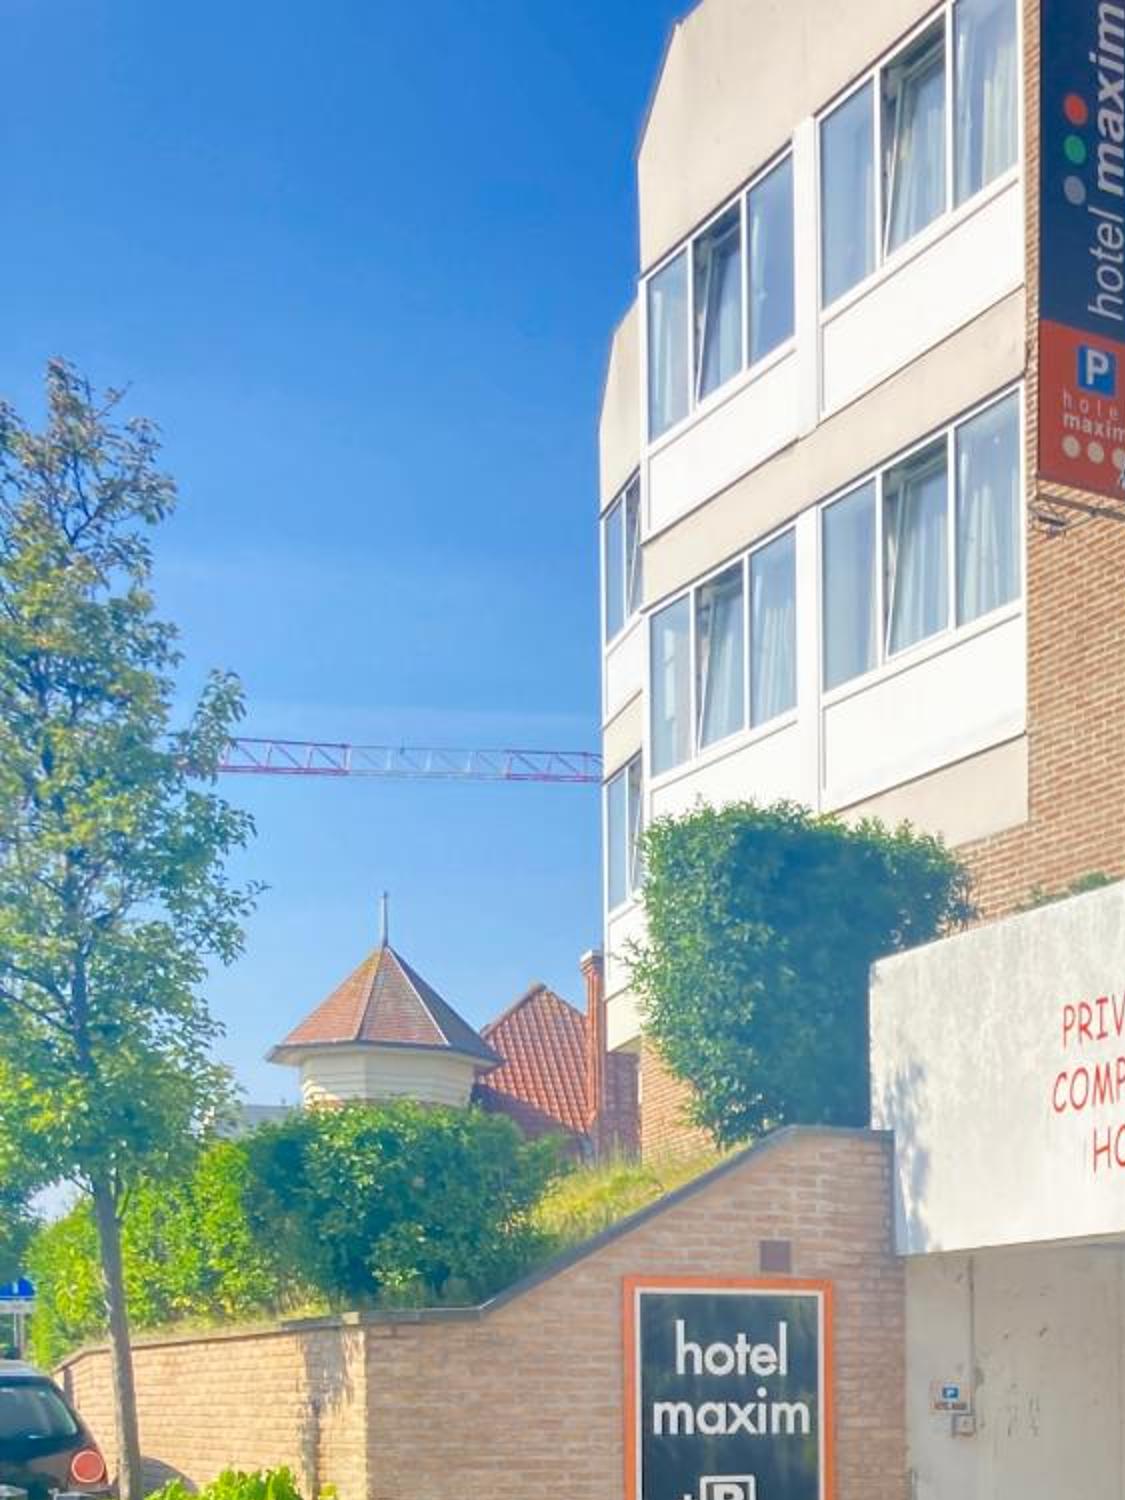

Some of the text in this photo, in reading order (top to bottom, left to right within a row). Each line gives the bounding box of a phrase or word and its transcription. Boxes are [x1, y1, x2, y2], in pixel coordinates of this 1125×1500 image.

[1087, 2, 1125, 321] hotel maxim
[1085, 349, 1109, 385] P
[675, 1319, 787, 1376] hotel
[653, 1387, 811, 1435] maxim
